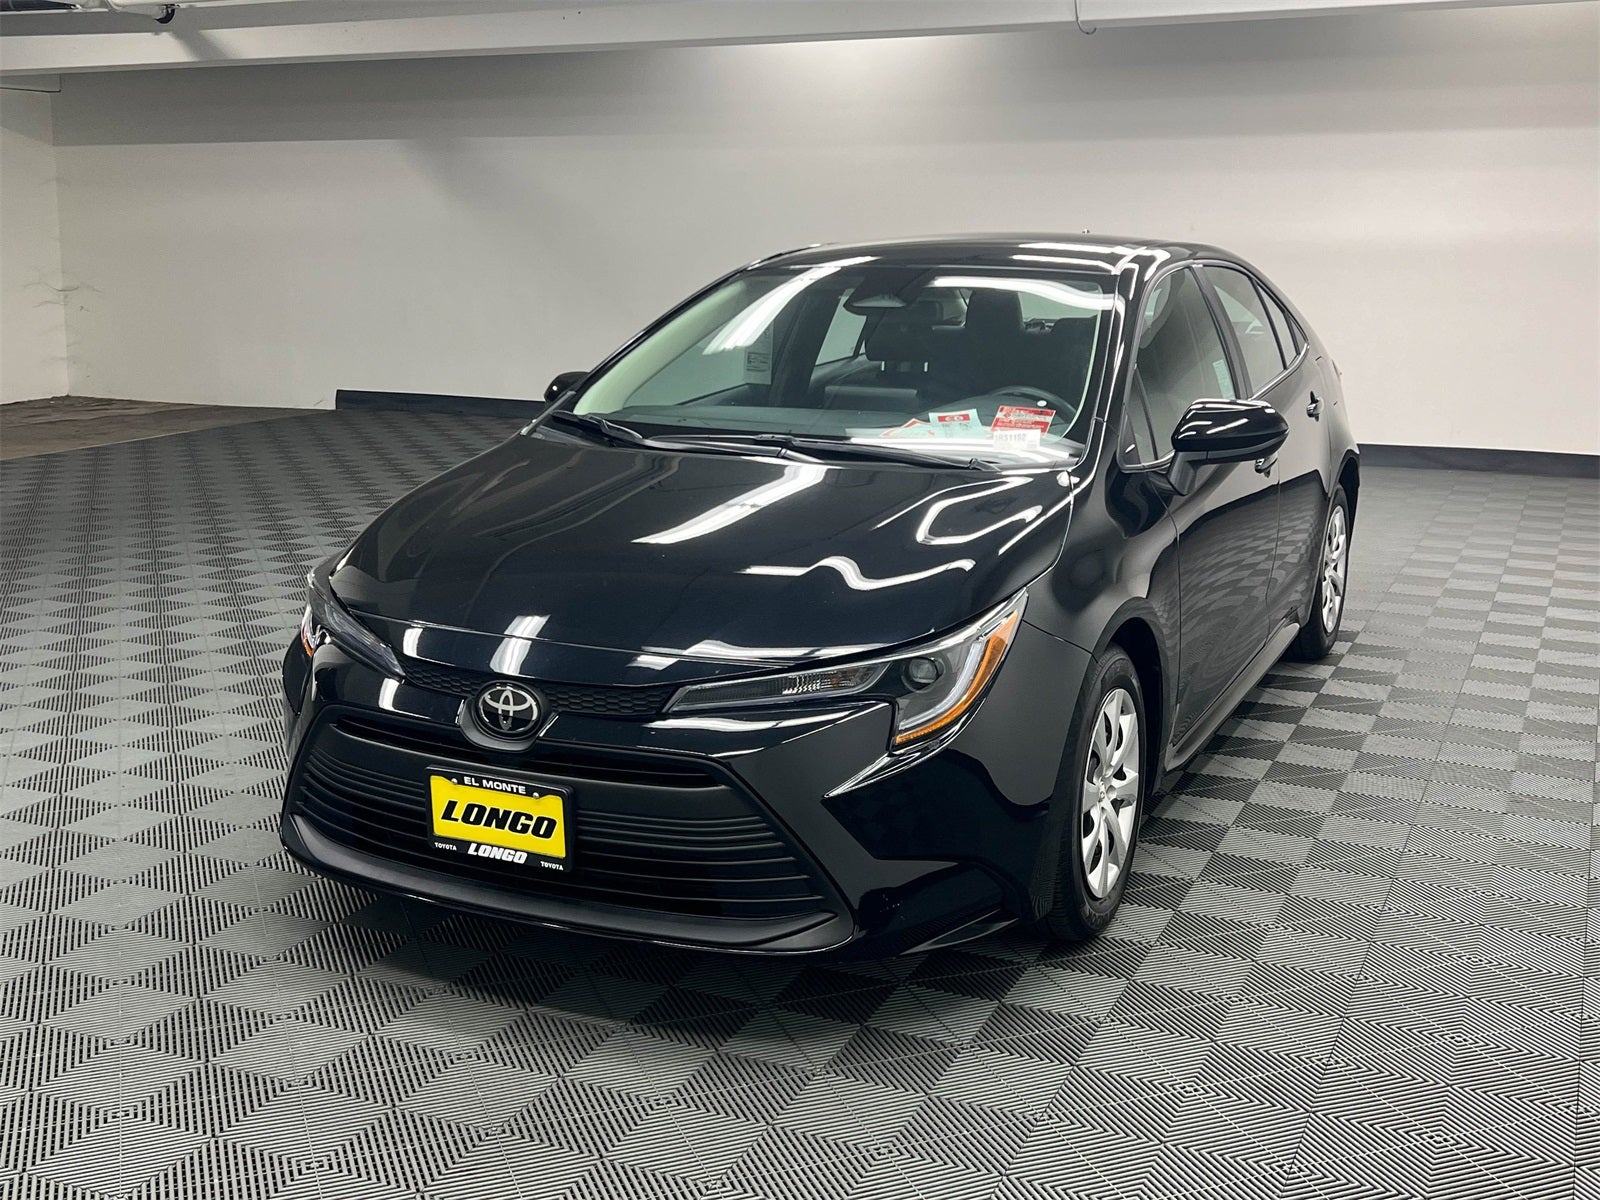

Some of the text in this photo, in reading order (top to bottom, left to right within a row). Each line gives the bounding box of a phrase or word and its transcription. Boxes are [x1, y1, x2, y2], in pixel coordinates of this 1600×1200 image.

[463, 777, 526, 794] EL MONTE
[441, 800, 557, 839] LONGO
[434, 842, 563, 870] TOYOTA LONGO TOYOTA
